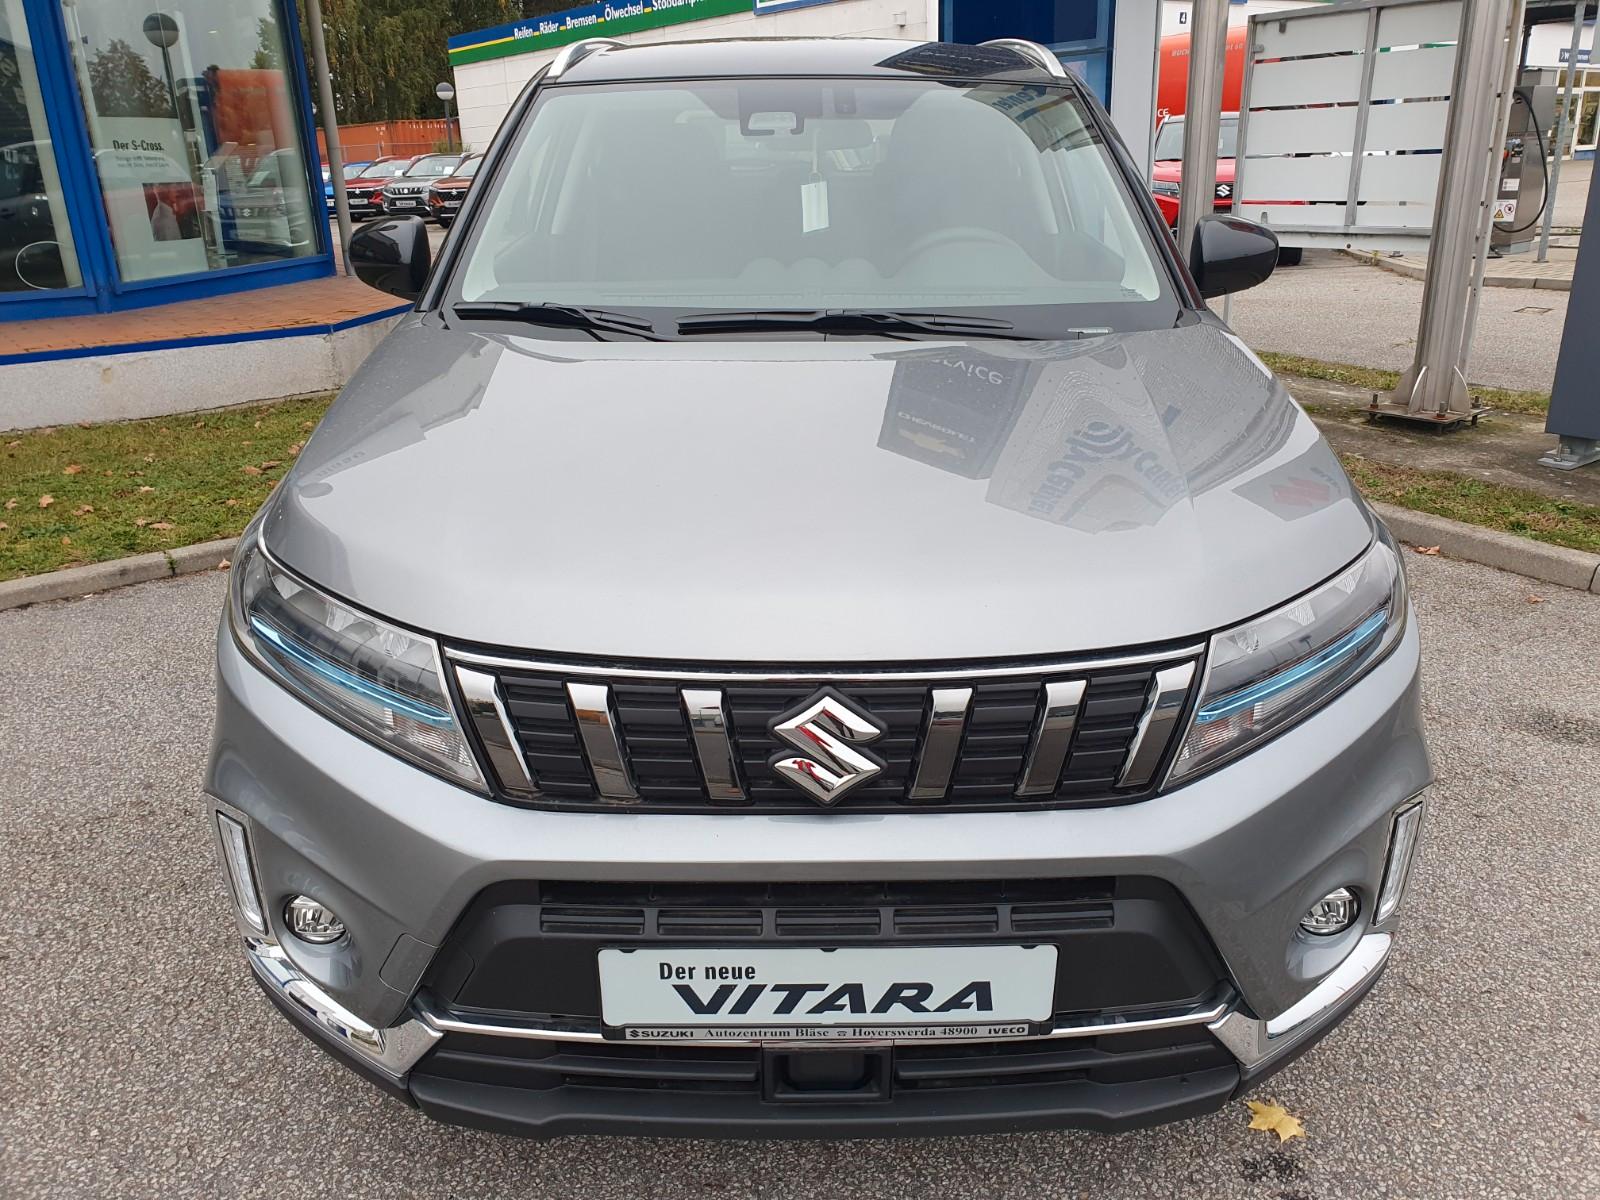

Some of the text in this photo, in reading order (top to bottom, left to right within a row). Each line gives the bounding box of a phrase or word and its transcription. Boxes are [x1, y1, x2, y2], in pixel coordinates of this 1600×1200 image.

[514, 27, 533, 40] Reifen
[539, 22, 560, 33] Räder
[566, 14, 597, 29] Bremsen
[604, 1, 644, 21] Ölwechsel
[659, 962, 756, 980] Der neue
[671, 981, 993, 1015] VITARA
[640, 1026, 1026, 1039] SUZUKI Autozentrum Bläse Hoyerswerda 48900 IVECO
